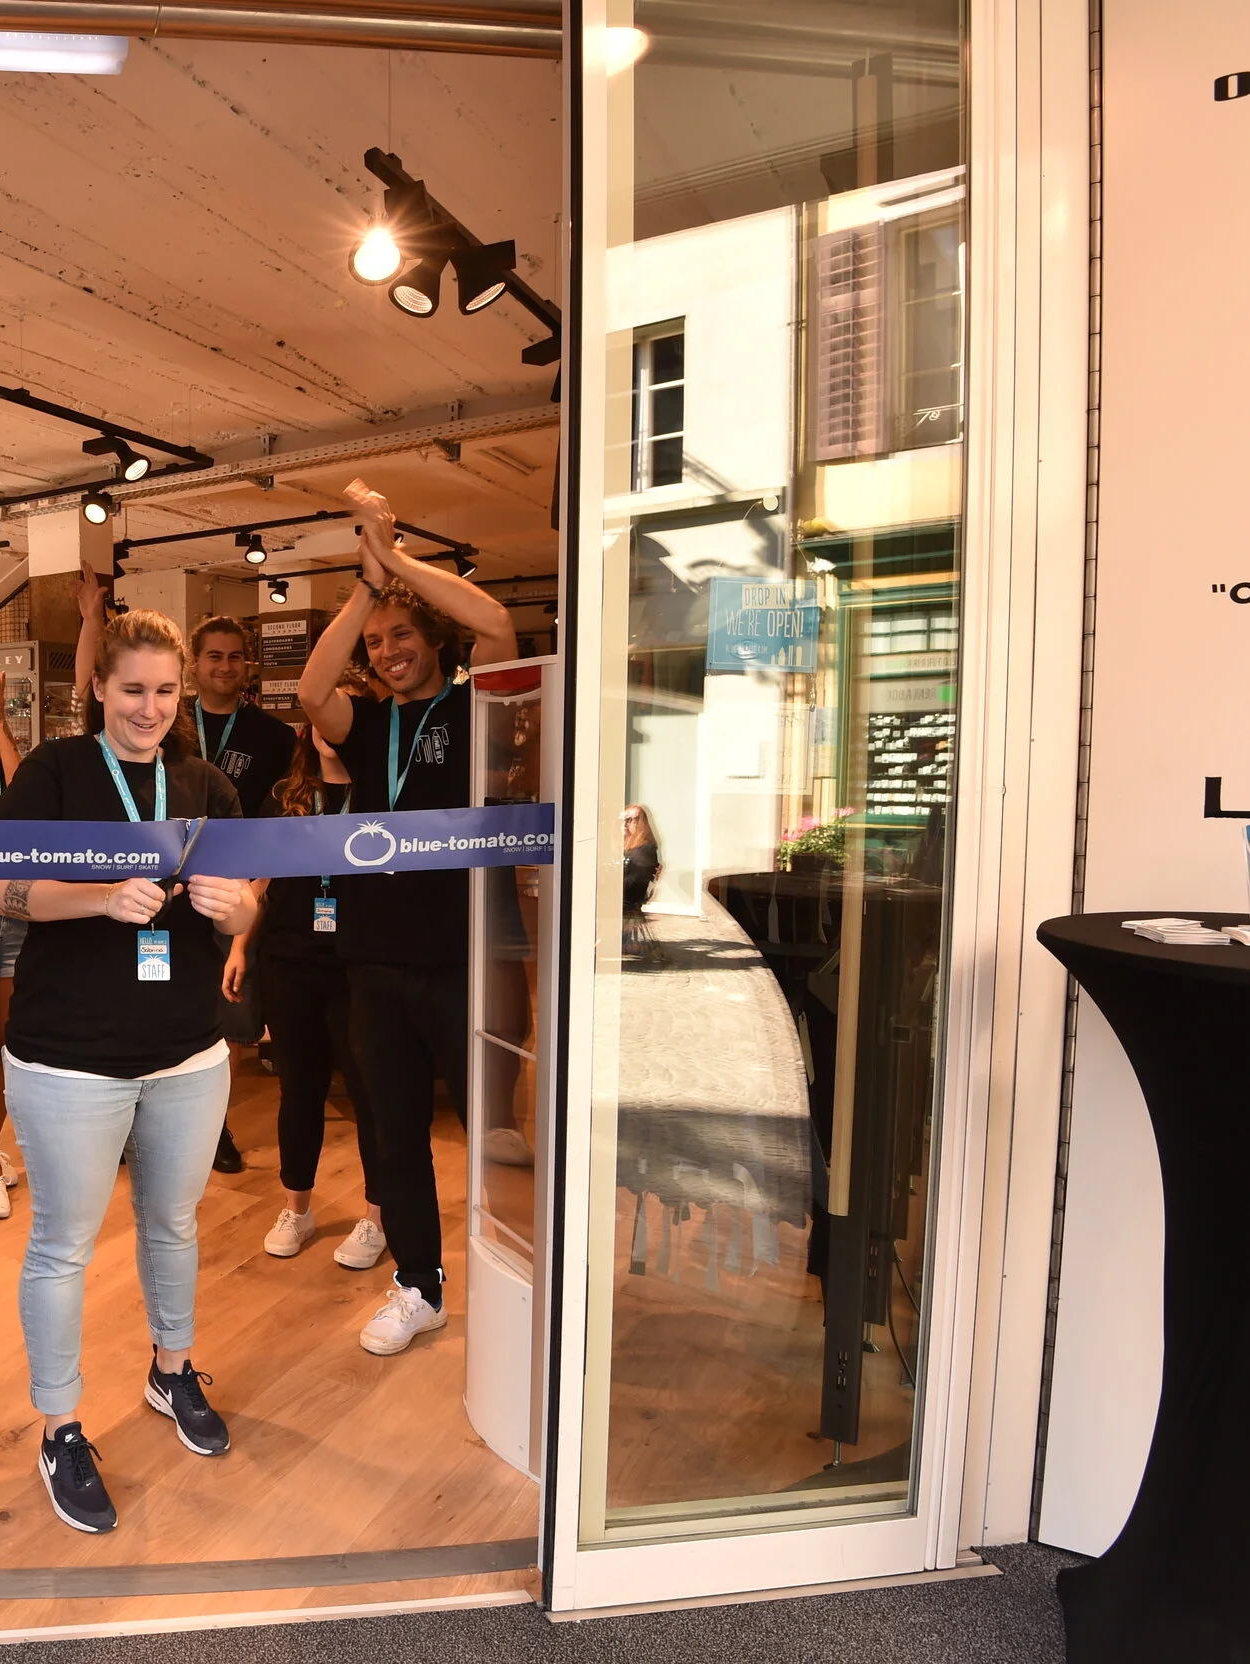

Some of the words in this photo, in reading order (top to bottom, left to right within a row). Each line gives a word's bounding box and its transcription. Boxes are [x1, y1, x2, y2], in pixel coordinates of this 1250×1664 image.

[744, 586, 770, 606] DROP
[776, 587, 786, 605] IN
[726, 608, 762, 636] WE'RE
[767, 610, 804, 638] OPEN!
[141, 964, 166, 979] STAFF
